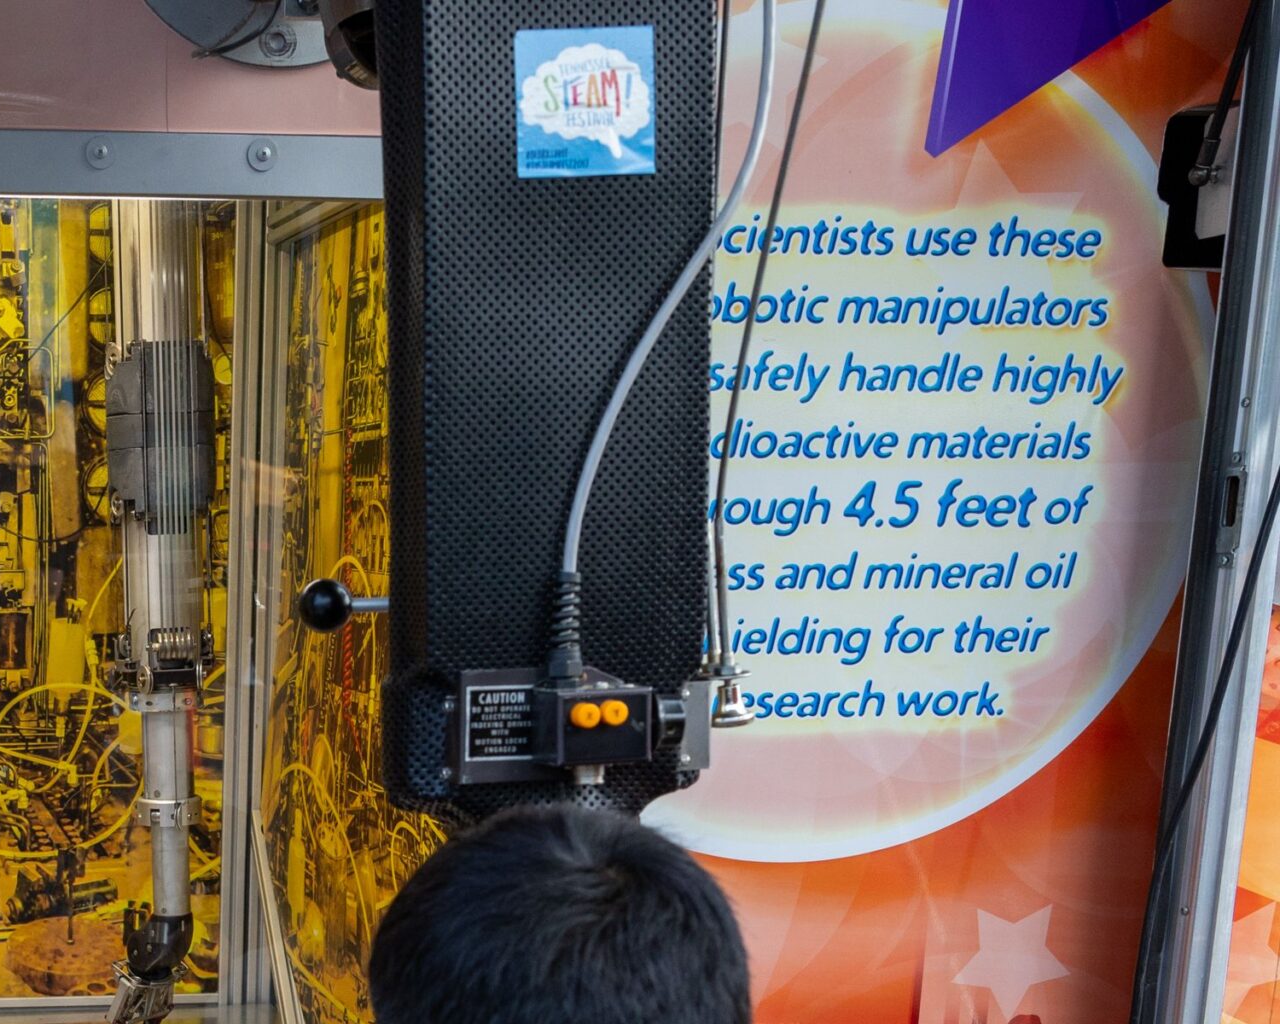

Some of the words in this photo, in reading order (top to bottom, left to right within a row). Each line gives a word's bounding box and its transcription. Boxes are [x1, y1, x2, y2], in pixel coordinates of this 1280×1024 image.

[717, 213, 893, 256] cientists
[906, 228, 976, 256] use
[989, 216, 1102, 258] these
[838, 284, 1108, 335] manipulators
[840, 352, 983, 393] handle
[993, 354, 1125, 405] highly
[908, 420, 1091, 460] materials
[844, 481, 923, 528] 4.5
[937, 479, 1037, 528] feet
[1045, 485, 1094, 525] of
[775, 551, 858, 591] and
[864, 553, 1019, 590] mineral
[1025, 552, 1078, 589] oil
[885, 615, 945, 653] for
[954, 616, 1050, 654] their
[478, 692, 526, 704] CAUTION
[897, 683, 1005, 717] work.
